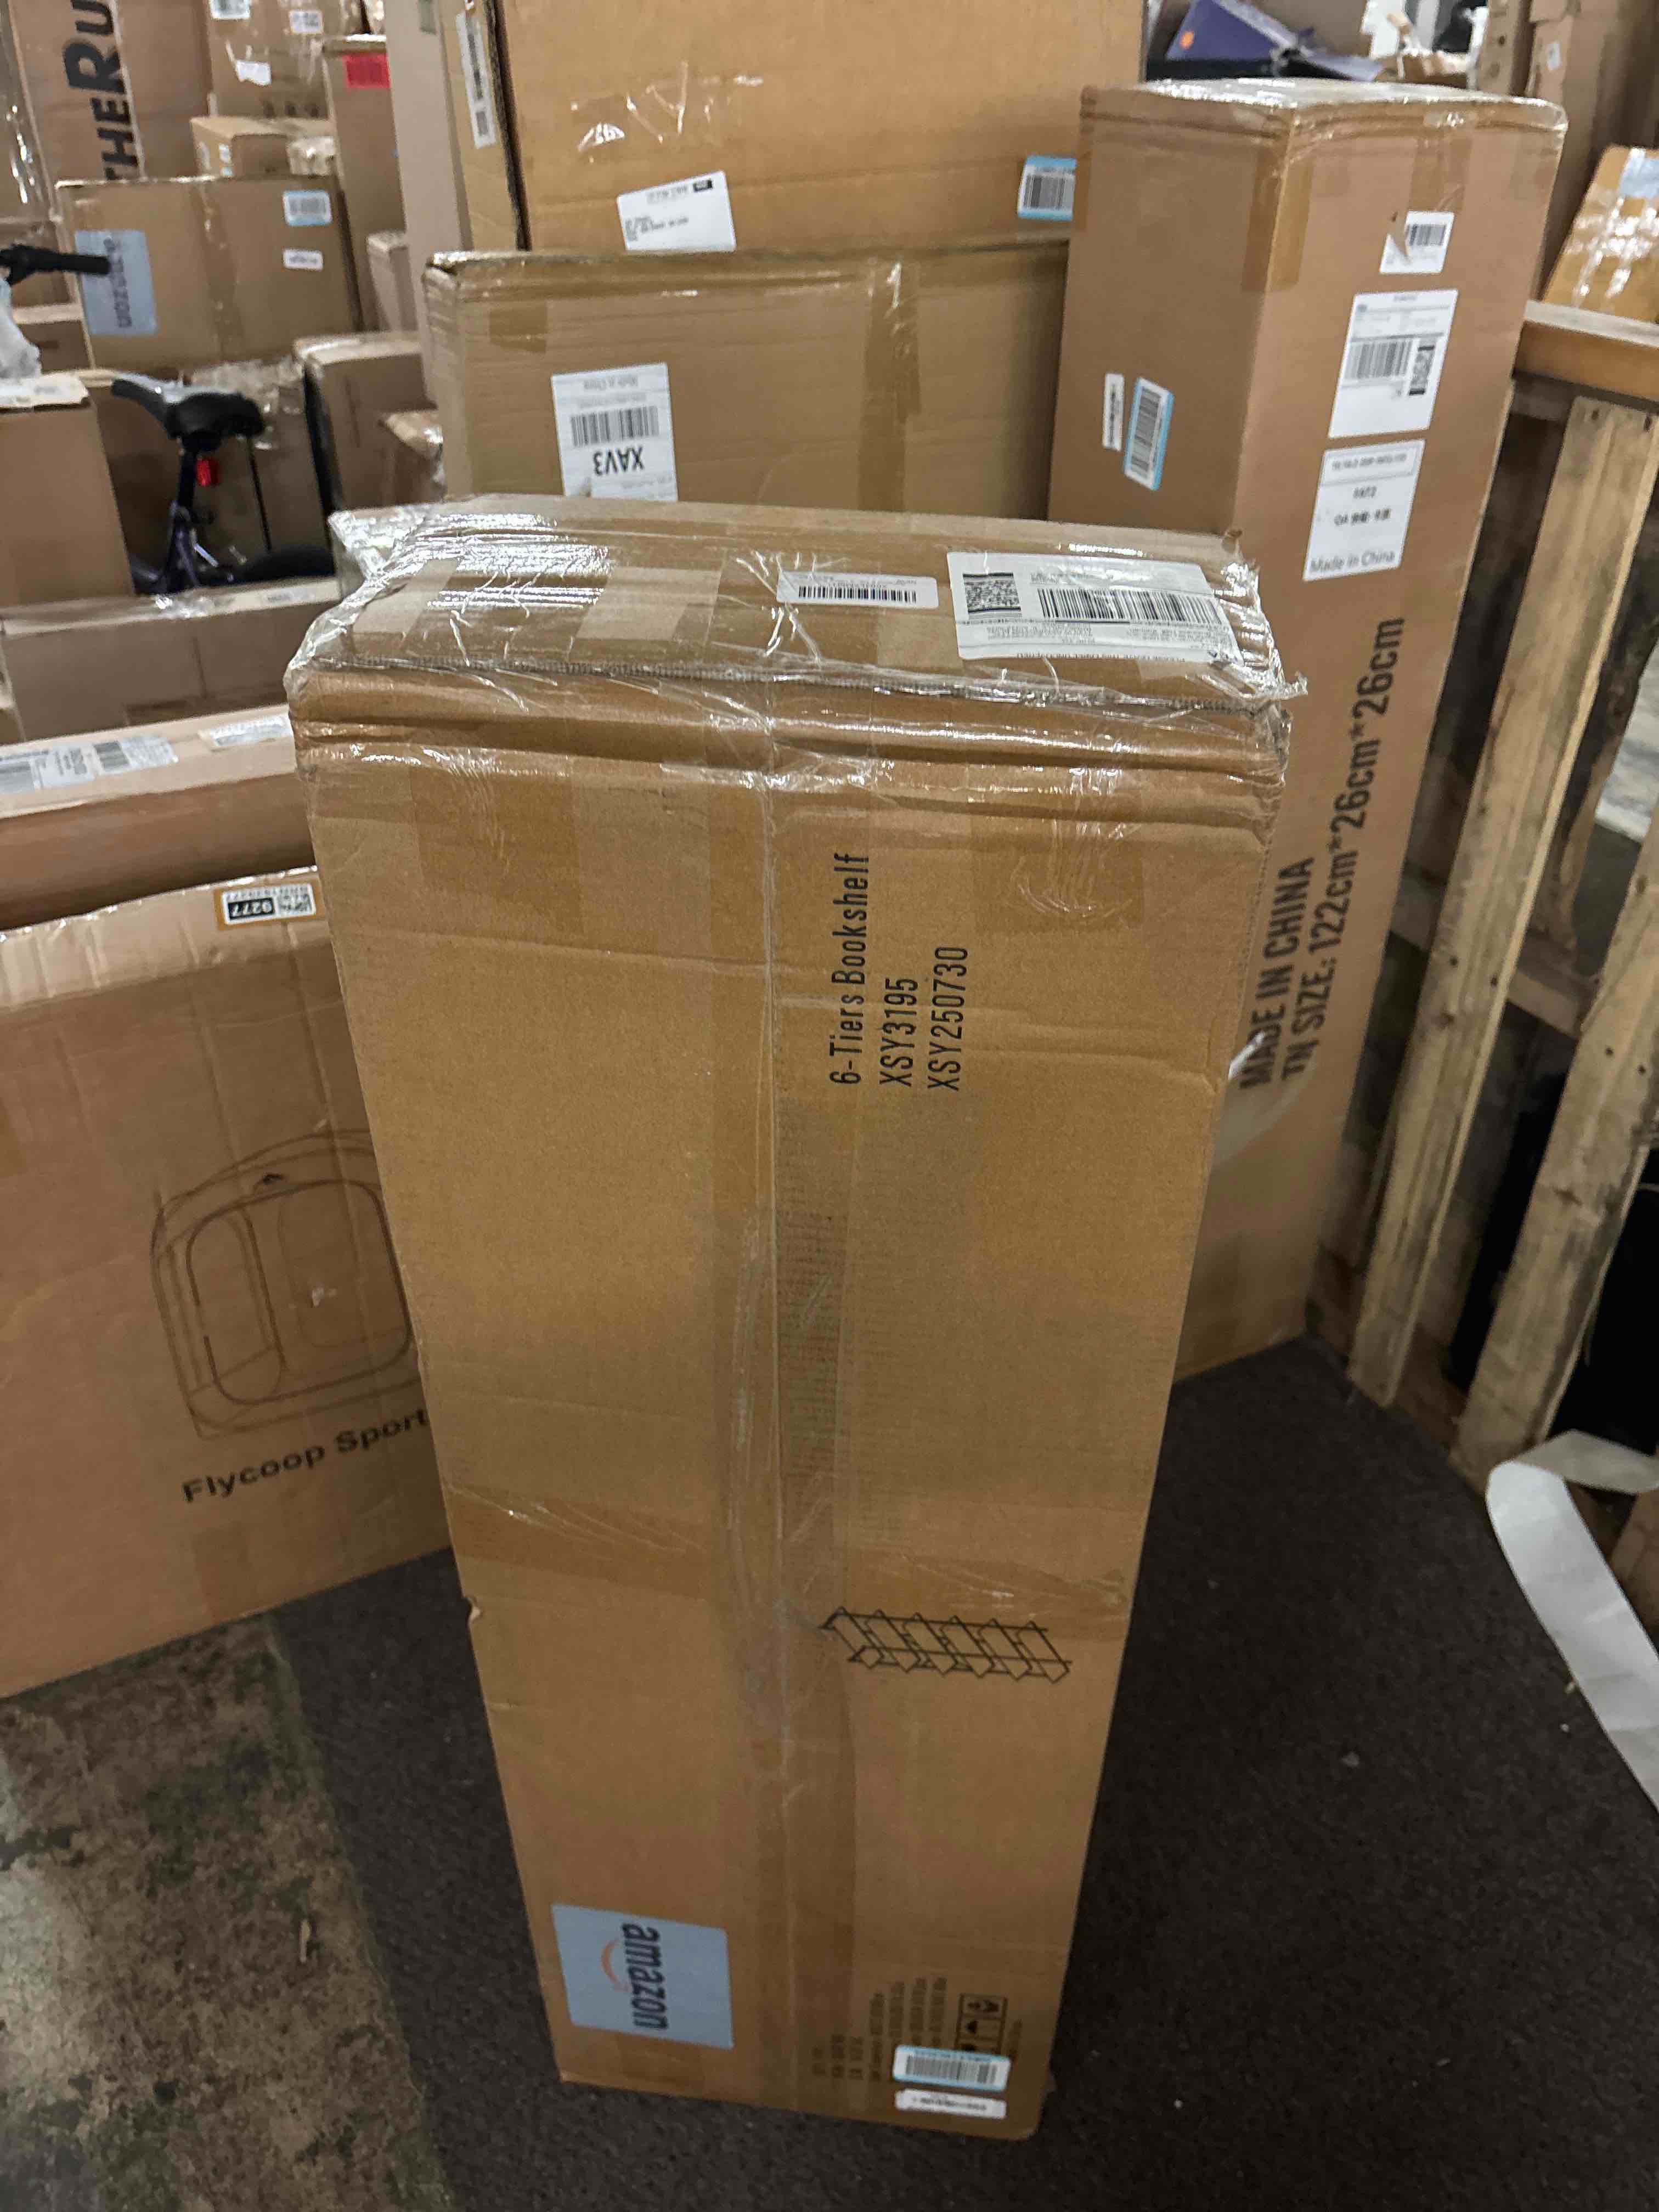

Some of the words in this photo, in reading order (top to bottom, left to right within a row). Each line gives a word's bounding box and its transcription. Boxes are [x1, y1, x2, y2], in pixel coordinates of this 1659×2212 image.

[61, 0, 139, 180] HERU
[593, 445, 645, 476] XAV3
[832, 853, 869, 985] Bookshelf
[1263, 857, 1314, 960] CHINA
[879, 978, 918, 1087] XSY3195
[927, 947, 968, 1091] XSY250730
[1255, 964, 1295, 1000] IN
[829, 994, 864, 1085] 6-Tiers
[1239, 1003, 1285, 1090] MADE
[182, 1446, 325, 1503] Flycoop
[621, 1923, 668, 2029] amazon
